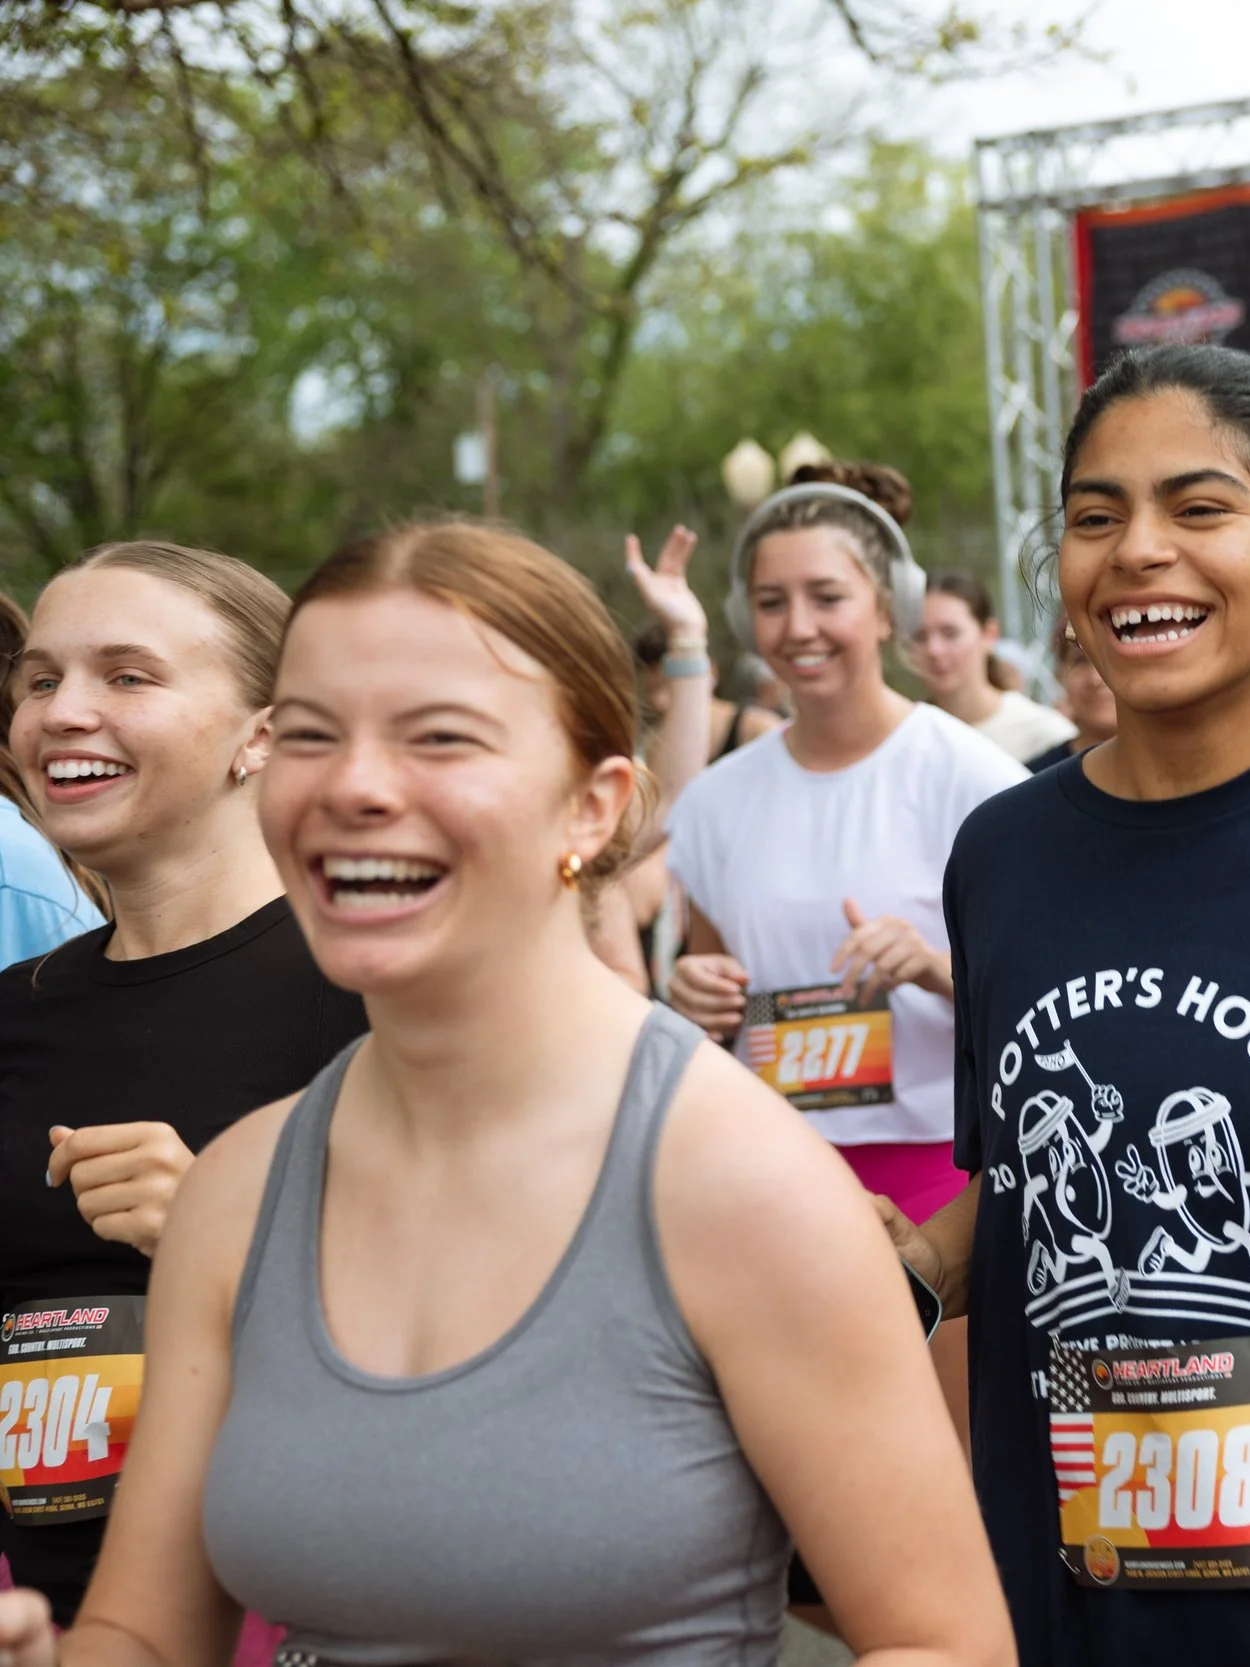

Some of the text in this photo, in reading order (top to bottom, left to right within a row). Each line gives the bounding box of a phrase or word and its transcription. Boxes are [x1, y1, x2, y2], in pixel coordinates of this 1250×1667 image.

[777, 1023, 869, 1084] 2277
[991, 967, 1164, 1121] POTTER'S
[988, 1163, 1016, 1195] 20
[15, 1307, 110, 1331] HEARTLAND
[1112, 1352, 1234, 1381] HEARTLAND
[0, 1373, 113, 1471] 2304
